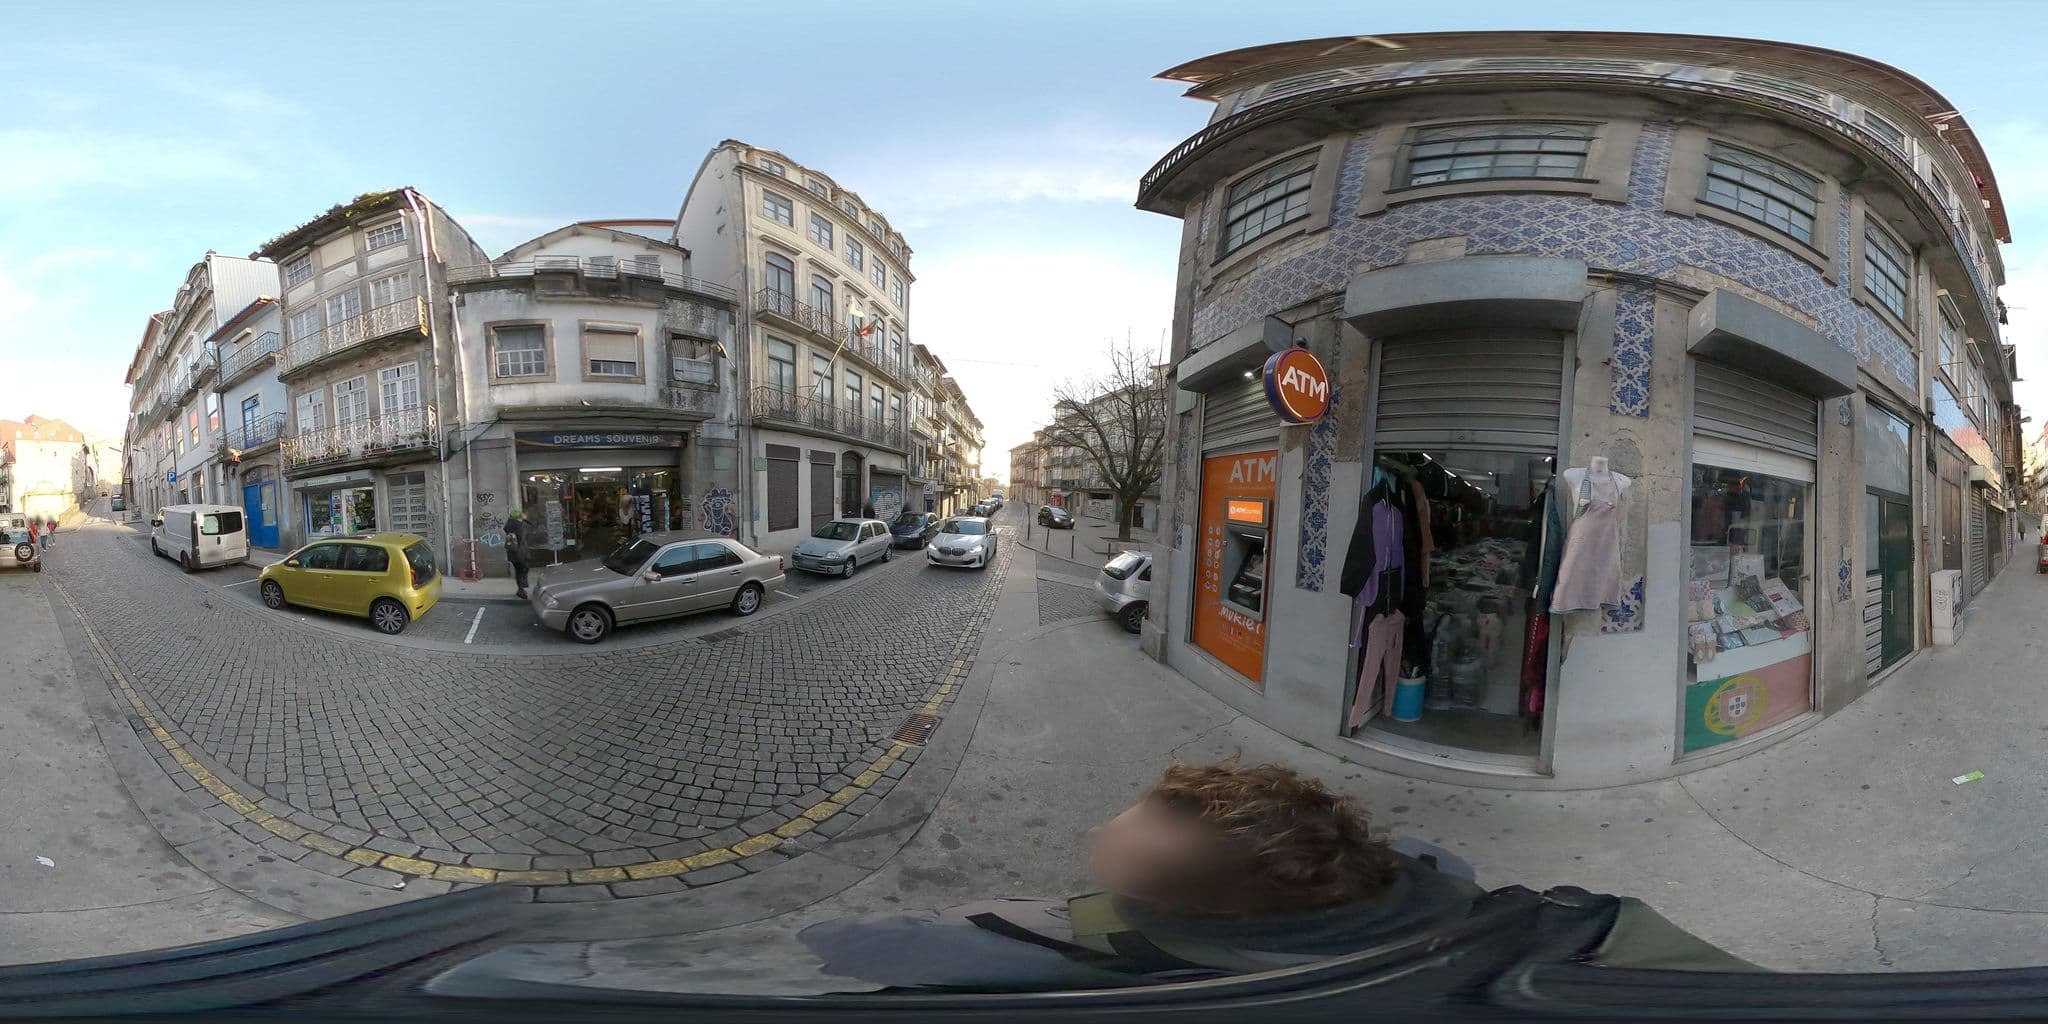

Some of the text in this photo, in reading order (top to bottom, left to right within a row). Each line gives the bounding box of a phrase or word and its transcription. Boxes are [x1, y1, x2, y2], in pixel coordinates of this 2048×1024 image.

[1282, 366, 1325, 402] ATM
[554, 434, 659, 444] DREAMS SOUVENIR
[1229, 457, 1277, 483] ATM
